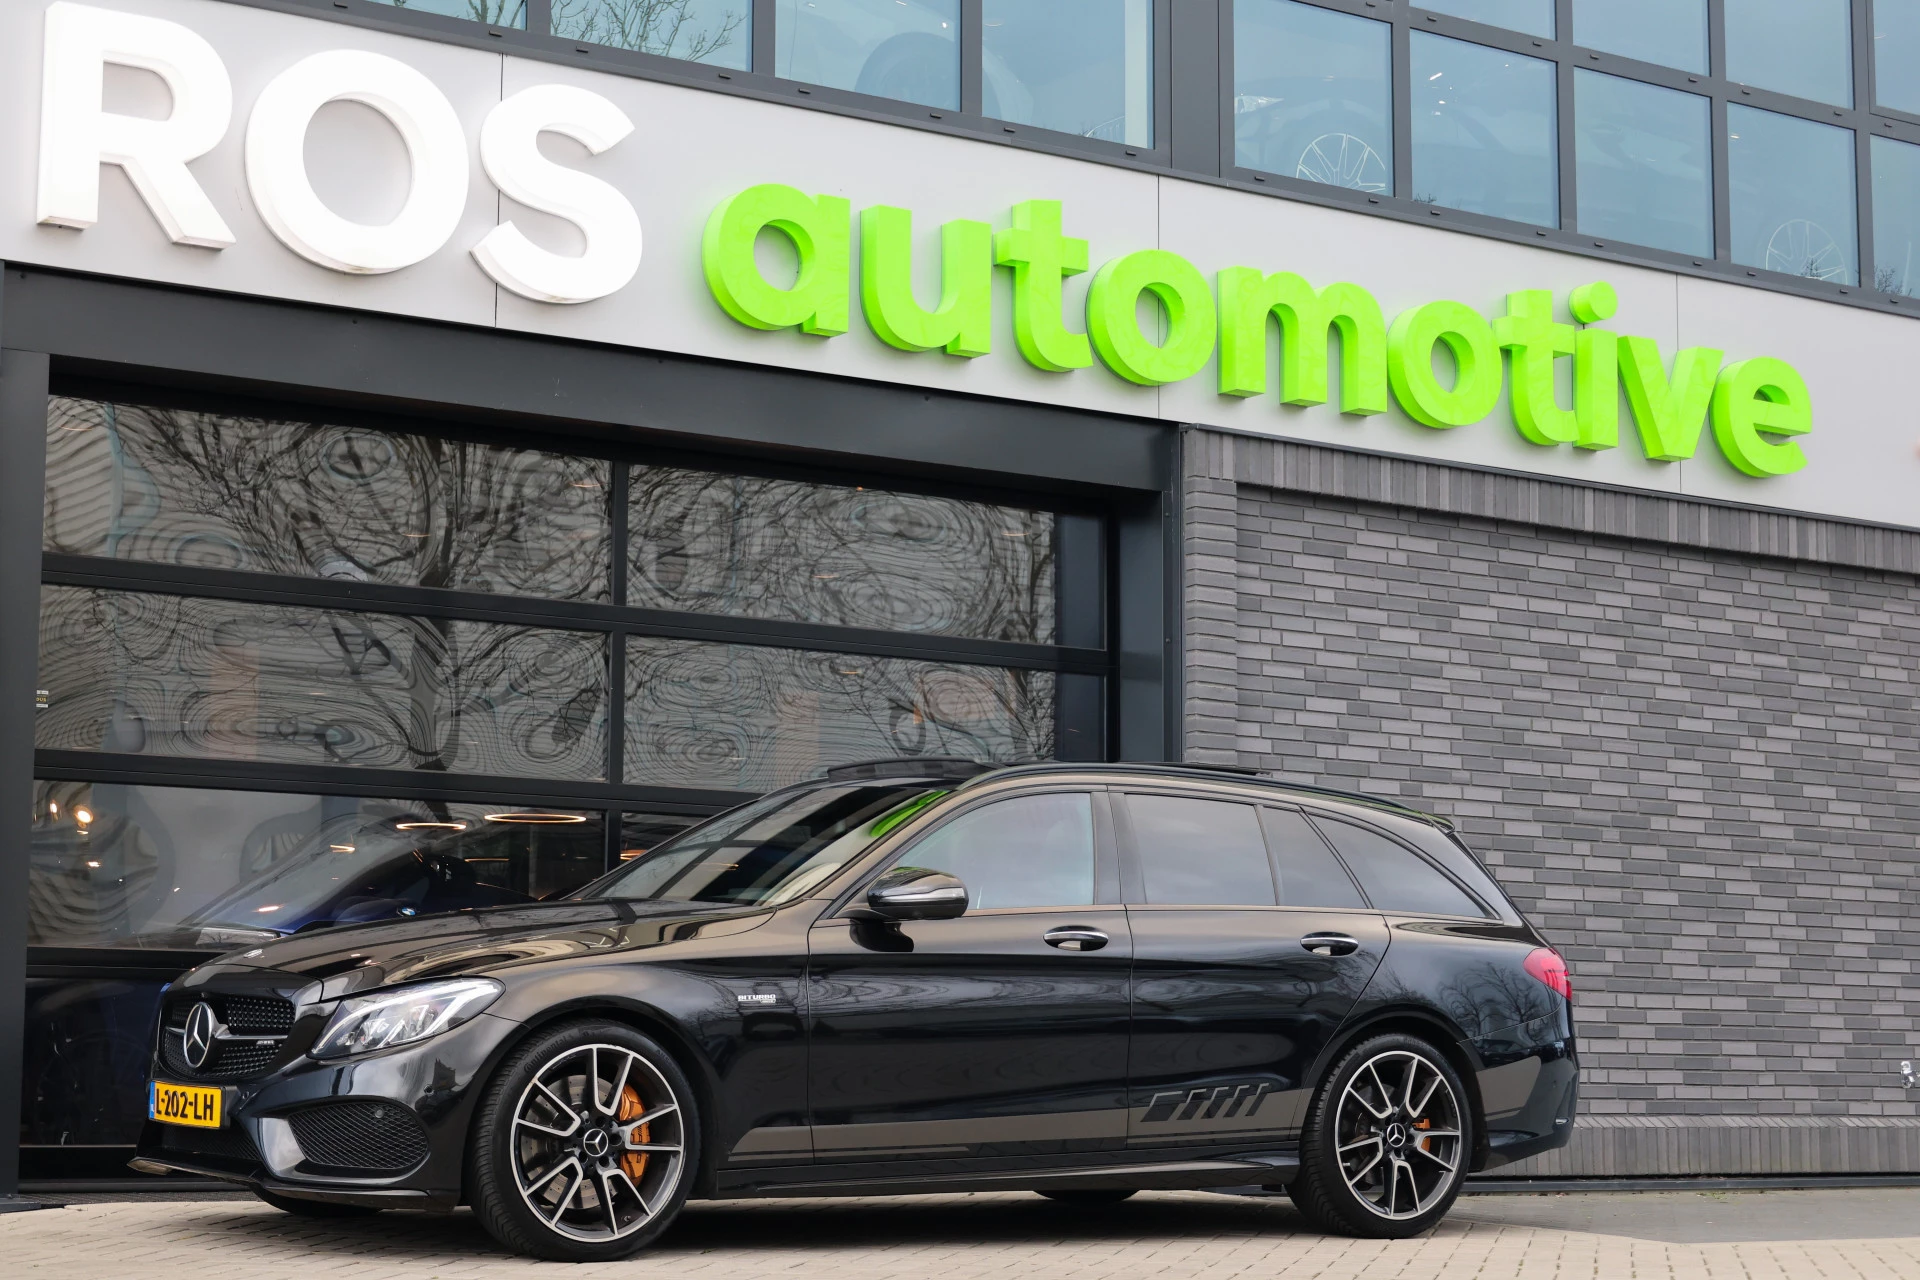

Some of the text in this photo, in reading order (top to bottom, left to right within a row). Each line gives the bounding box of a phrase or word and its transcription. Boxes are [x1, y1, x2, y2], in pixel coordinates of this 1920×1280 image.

[37, 1, 1812, 479] ROS automotive
[156, 1087, 214, 1122] L-202-LH
